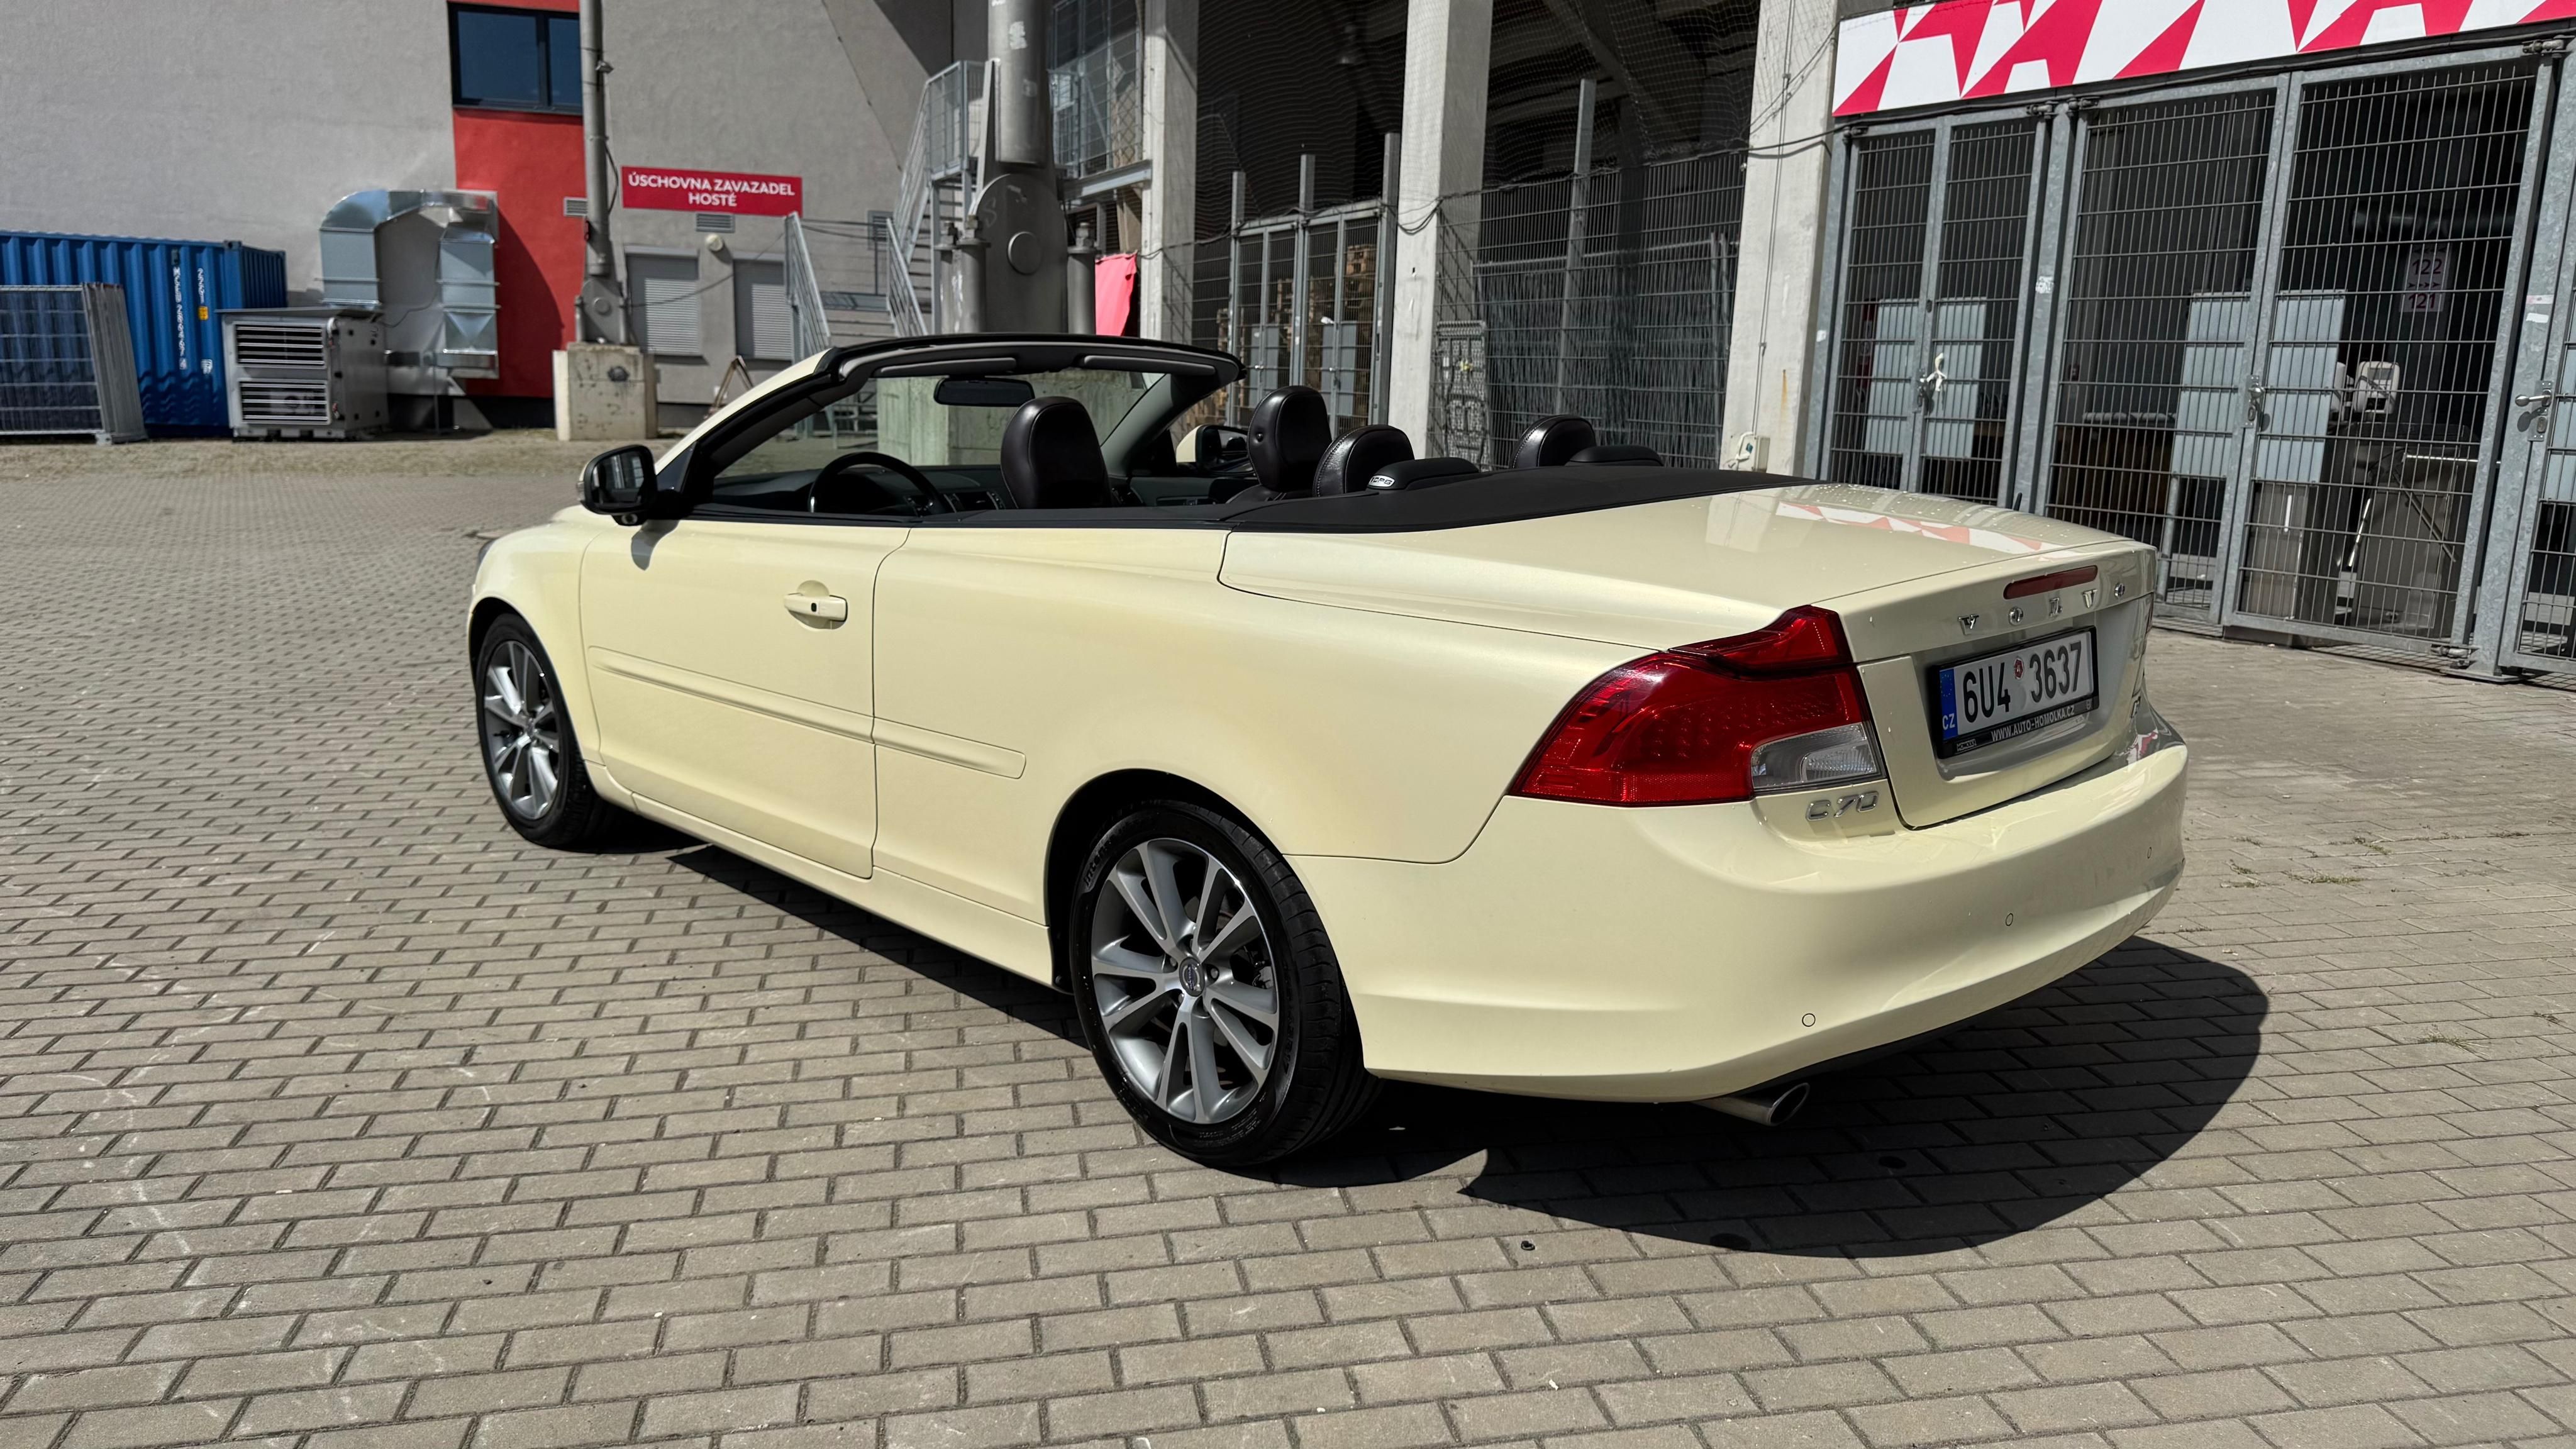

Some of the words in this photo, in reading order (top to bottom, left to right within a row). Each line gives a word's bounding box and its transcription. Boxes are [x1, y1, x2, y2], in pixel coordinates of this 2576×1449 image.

[629, 172, 712, 191] ÚSCHOVNA
[714, 179, 795, 196] ZAVAZADEL
[689, 191, 737, 207] HOSTÉ
[2412, 258, 2442, 275] 122
[2409, 292, 2435, 309] 121
[1962, 662, 2011, 723] 6U4
[2029, 640, 2082, 703] 3637
[1942, 713, 1955, 731] CZ
[1990, 705, 2075, 742] WWW.AUTO-HOMOLKA.CZ
[1805, 790, 1879, 820] C70
